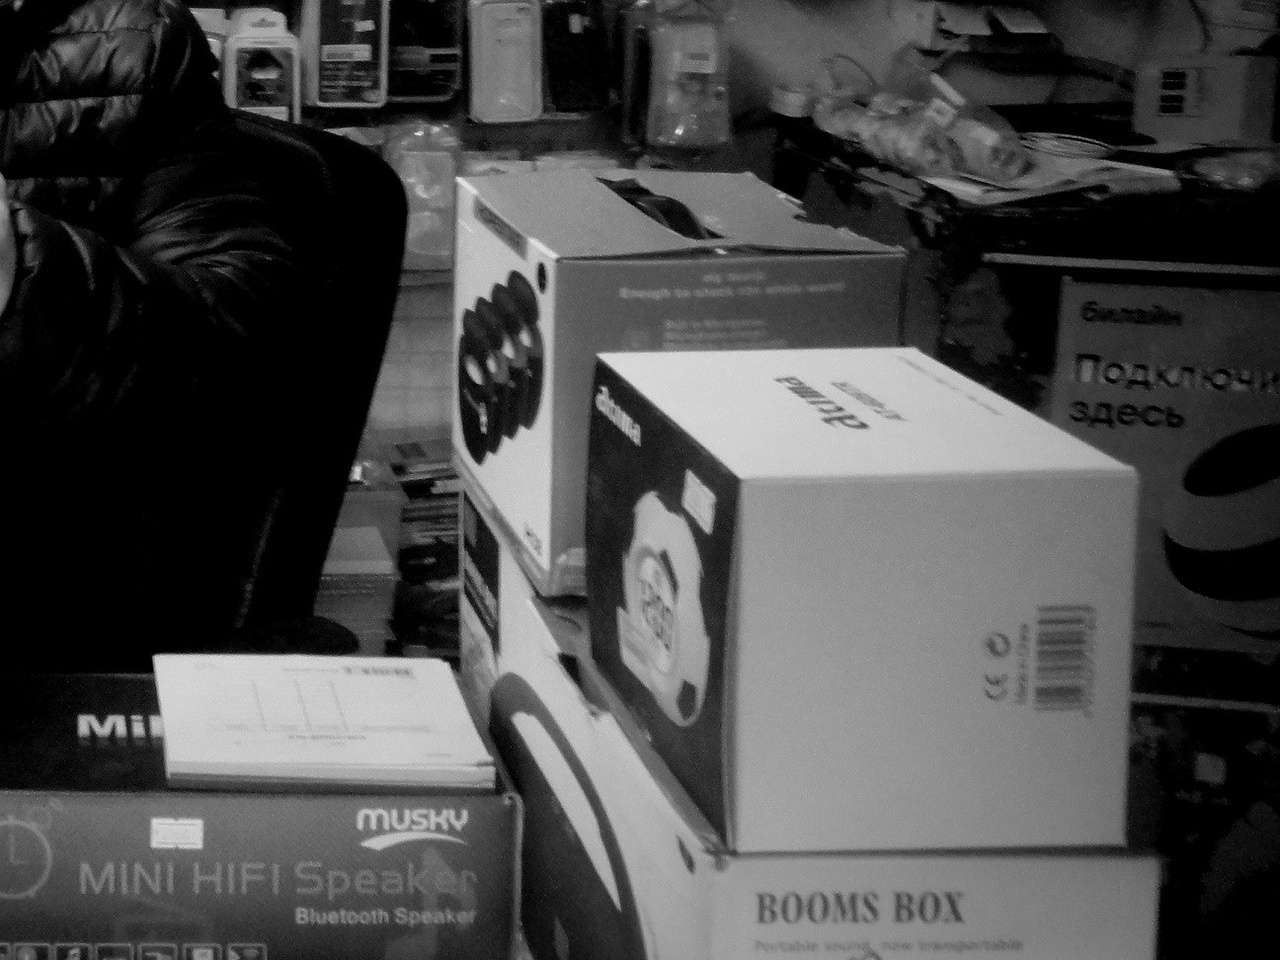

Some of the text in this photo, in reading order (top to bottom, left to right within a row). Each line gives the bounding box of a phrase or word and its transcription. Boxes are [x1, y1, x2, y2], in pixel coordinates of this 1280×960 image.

[1070, 400, 1186, 430] здесь
[79, 860, 479, 901] MINI HIFI Speaker
[294, 906, 479, 928] Bluetooth Speaker
[755, 891, 967, 924] BOOMS BOX
